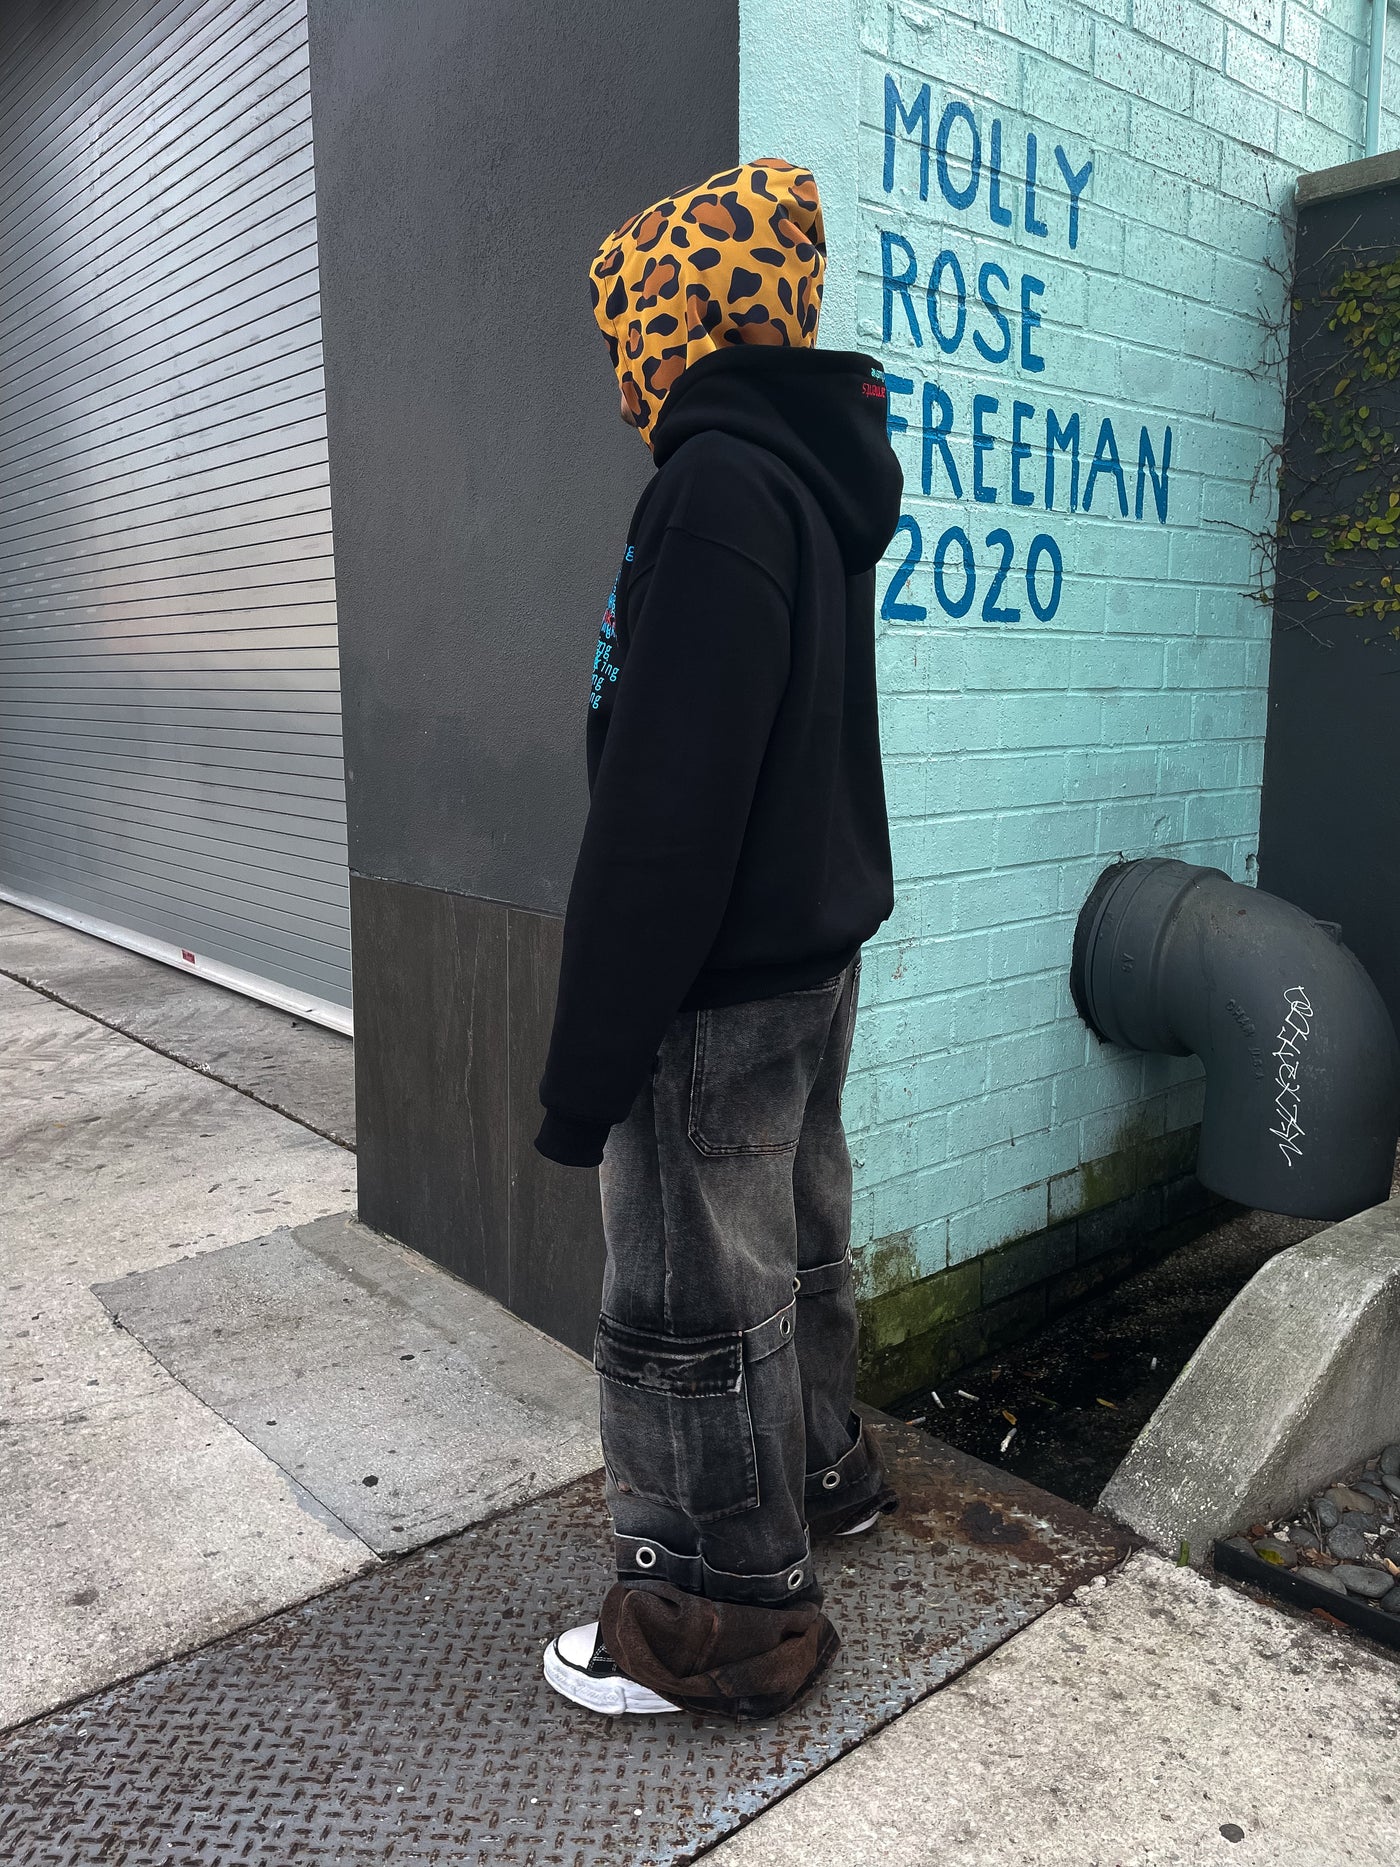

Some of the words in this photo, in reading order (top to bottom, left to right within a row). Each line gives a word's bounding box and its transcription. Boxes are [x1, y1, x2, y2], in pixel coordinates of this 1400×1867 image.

[882, 73, 1093, 250] MOLLY
[880, 229, 1047, 374] ROSE
[884, 372, 1173, 526] FREEMAN
[879, 512, 1065, 624] 2020
